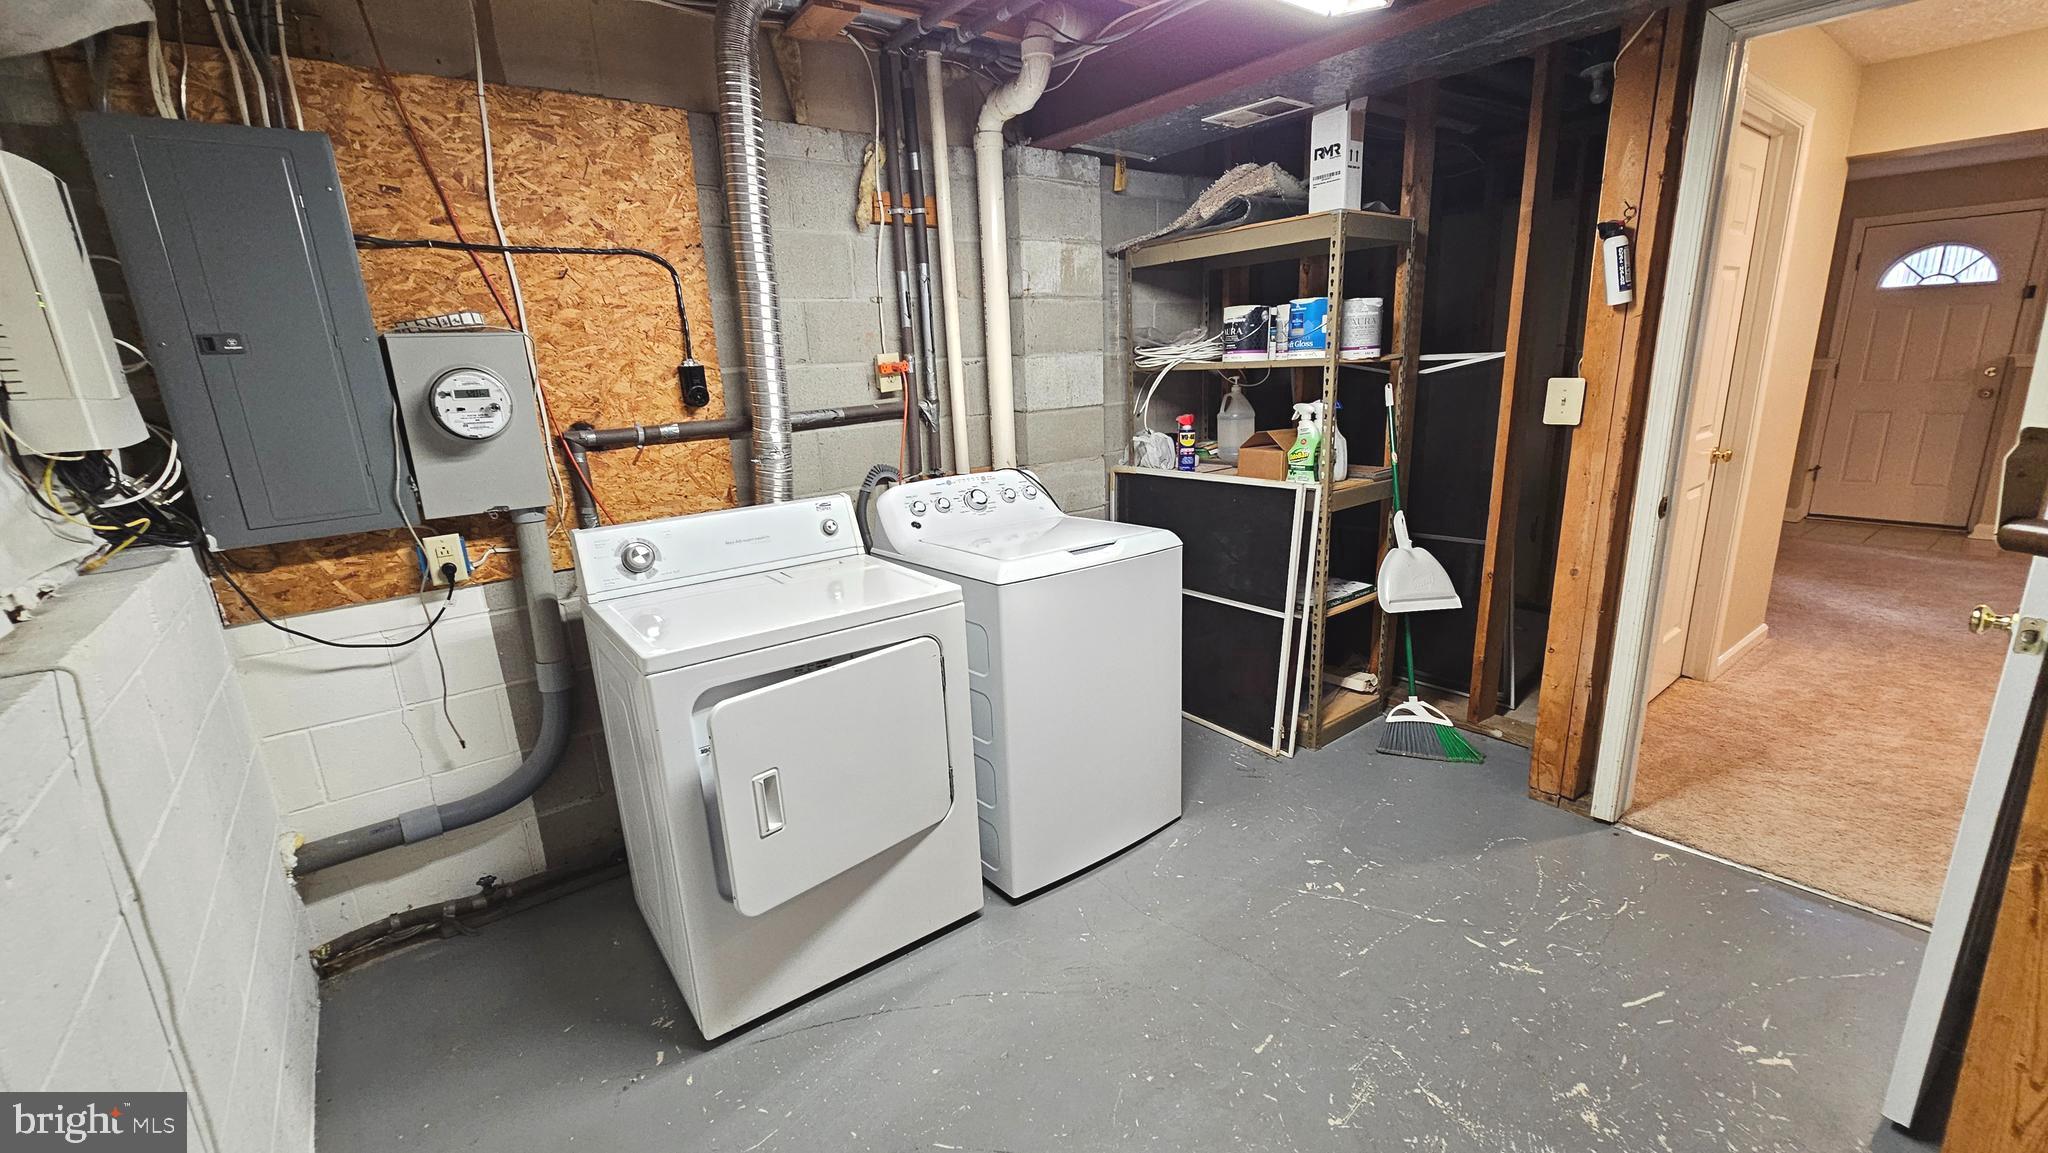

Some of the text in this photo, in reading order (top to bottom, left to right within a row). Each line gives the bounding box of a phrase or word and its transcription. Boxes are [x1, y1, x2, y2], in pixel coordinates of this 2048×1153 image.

[1314, 143, 1341, 161] RMR
[1352, 317, 1377, 325] AURA
[1294, 340, 1314, 348] Gloss
